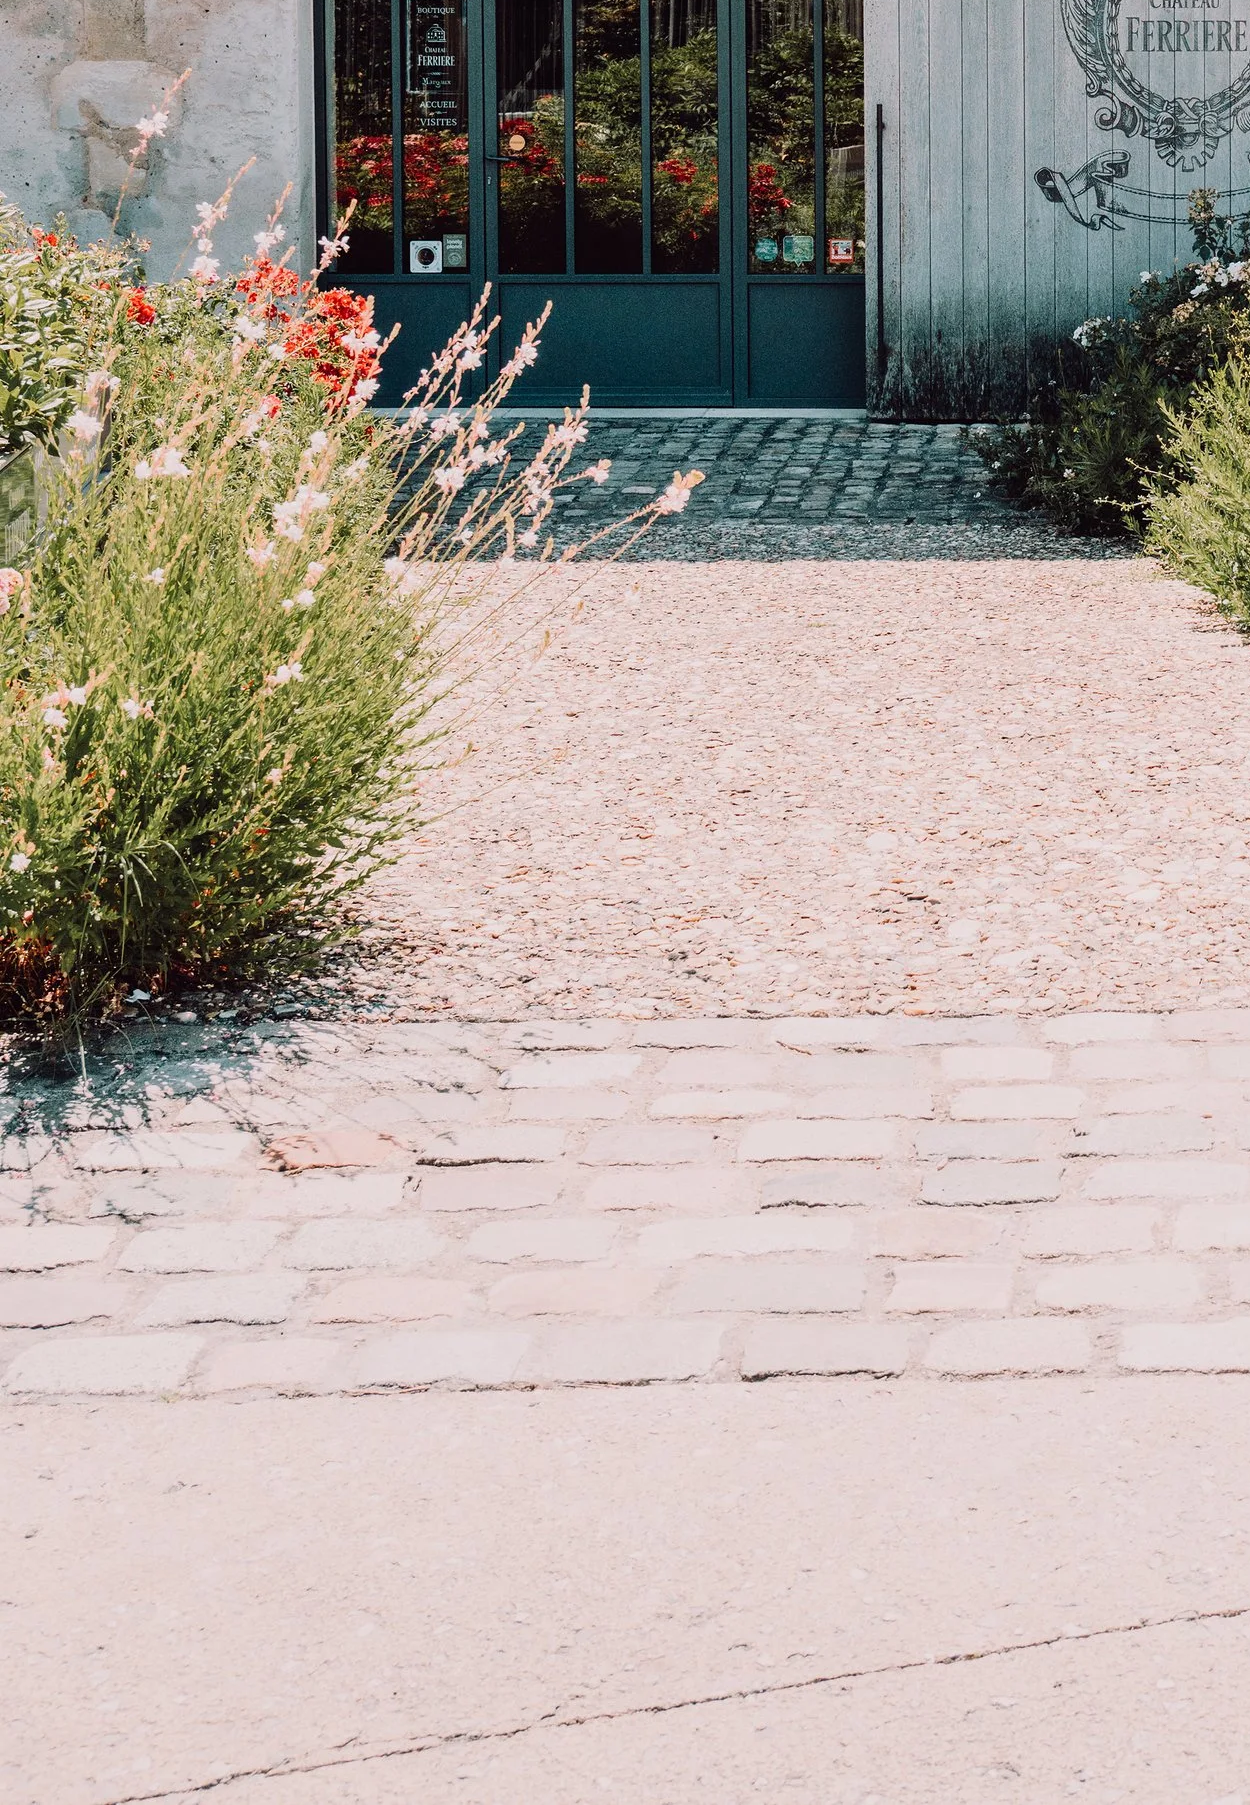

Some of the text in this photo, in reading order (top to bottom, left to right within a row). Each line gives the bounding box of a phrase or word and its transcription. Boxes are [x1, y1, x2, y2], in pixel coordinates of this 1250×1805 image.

[417, 7, 456, 15] BOUTIQUE
[1125, 16, 1248, 52] FERRIERE
[417, 54, 456, 67] FERRIERE
[419, 101, 458, 109] ACCUEIL
[420, 118, 458, 127] VISITES
